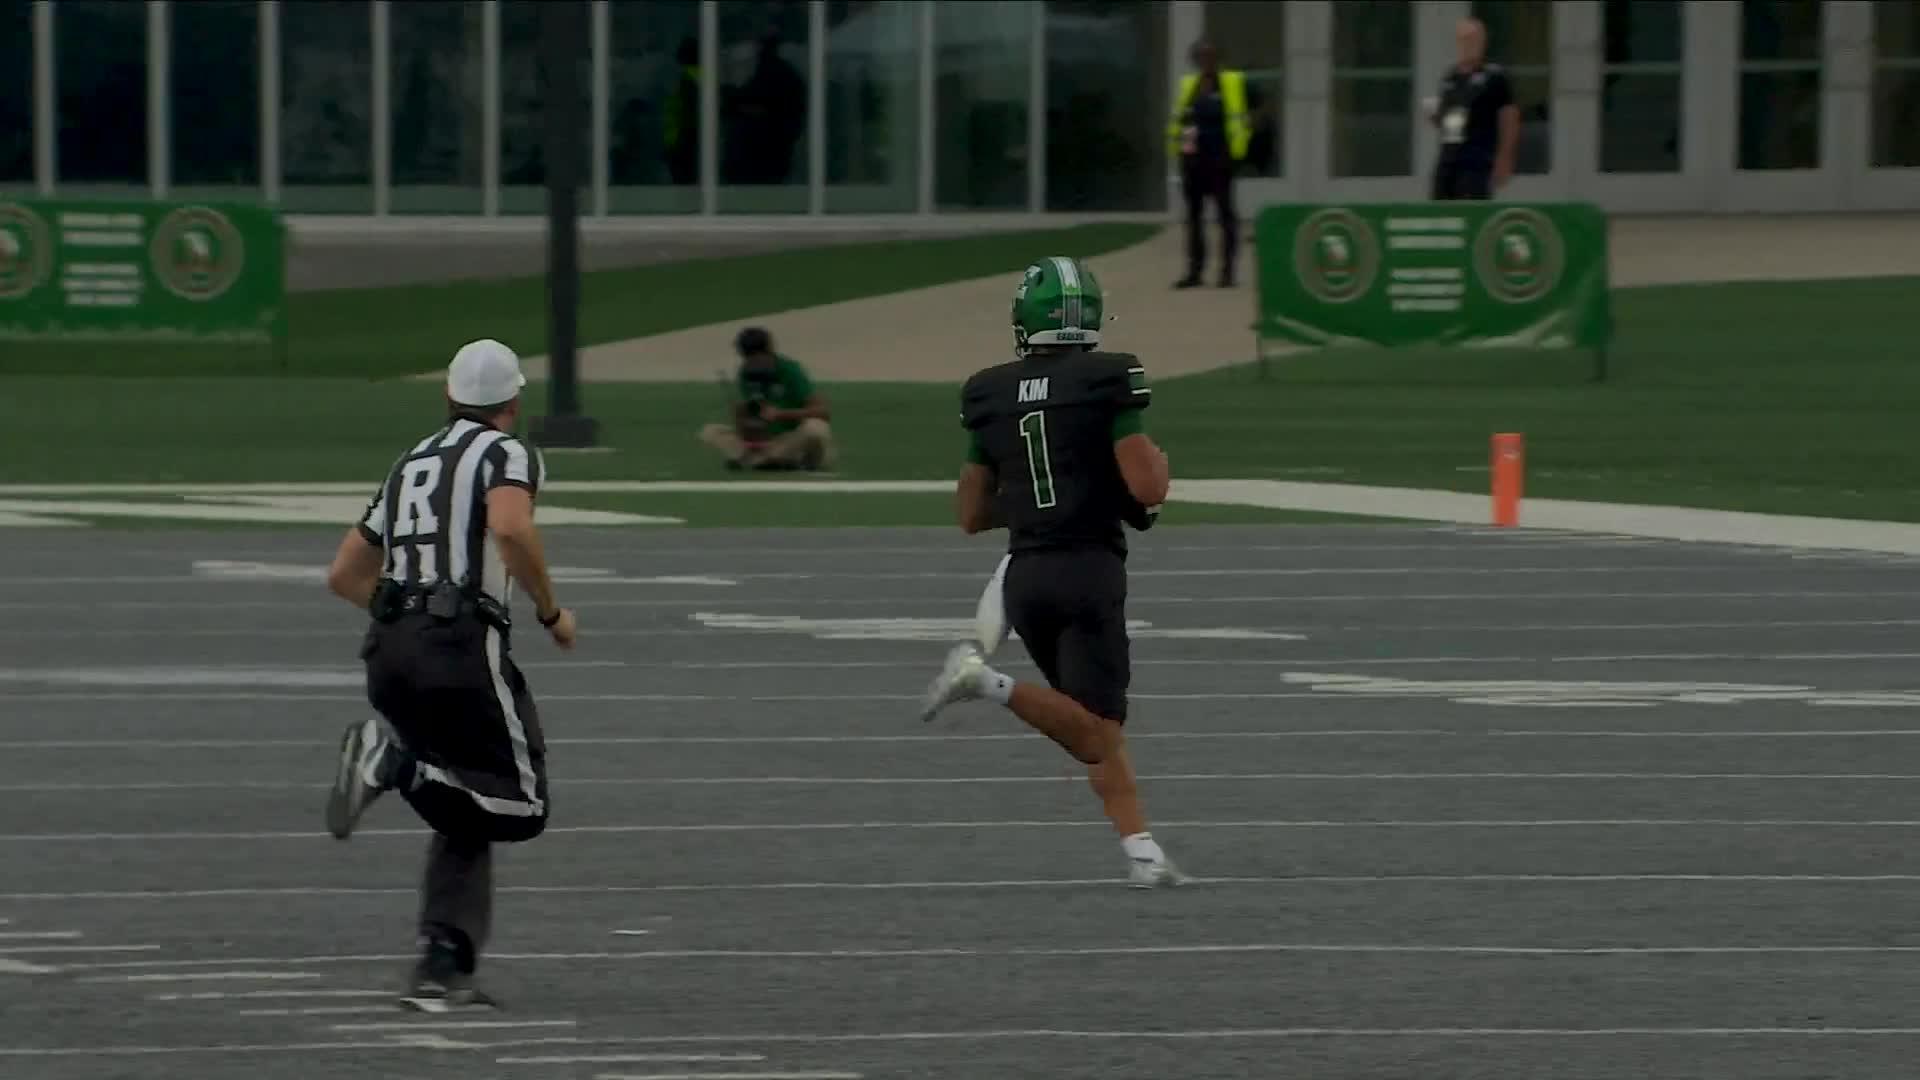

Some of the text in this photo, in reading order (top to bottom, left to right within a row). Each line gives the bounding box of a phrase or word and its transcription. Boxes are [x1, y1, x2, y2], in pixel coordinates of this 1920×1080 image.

[1018, 377, 1049, 402] KIM
[393, 455, 443, 537] R
[1019, 410, 1056, 508] 1
